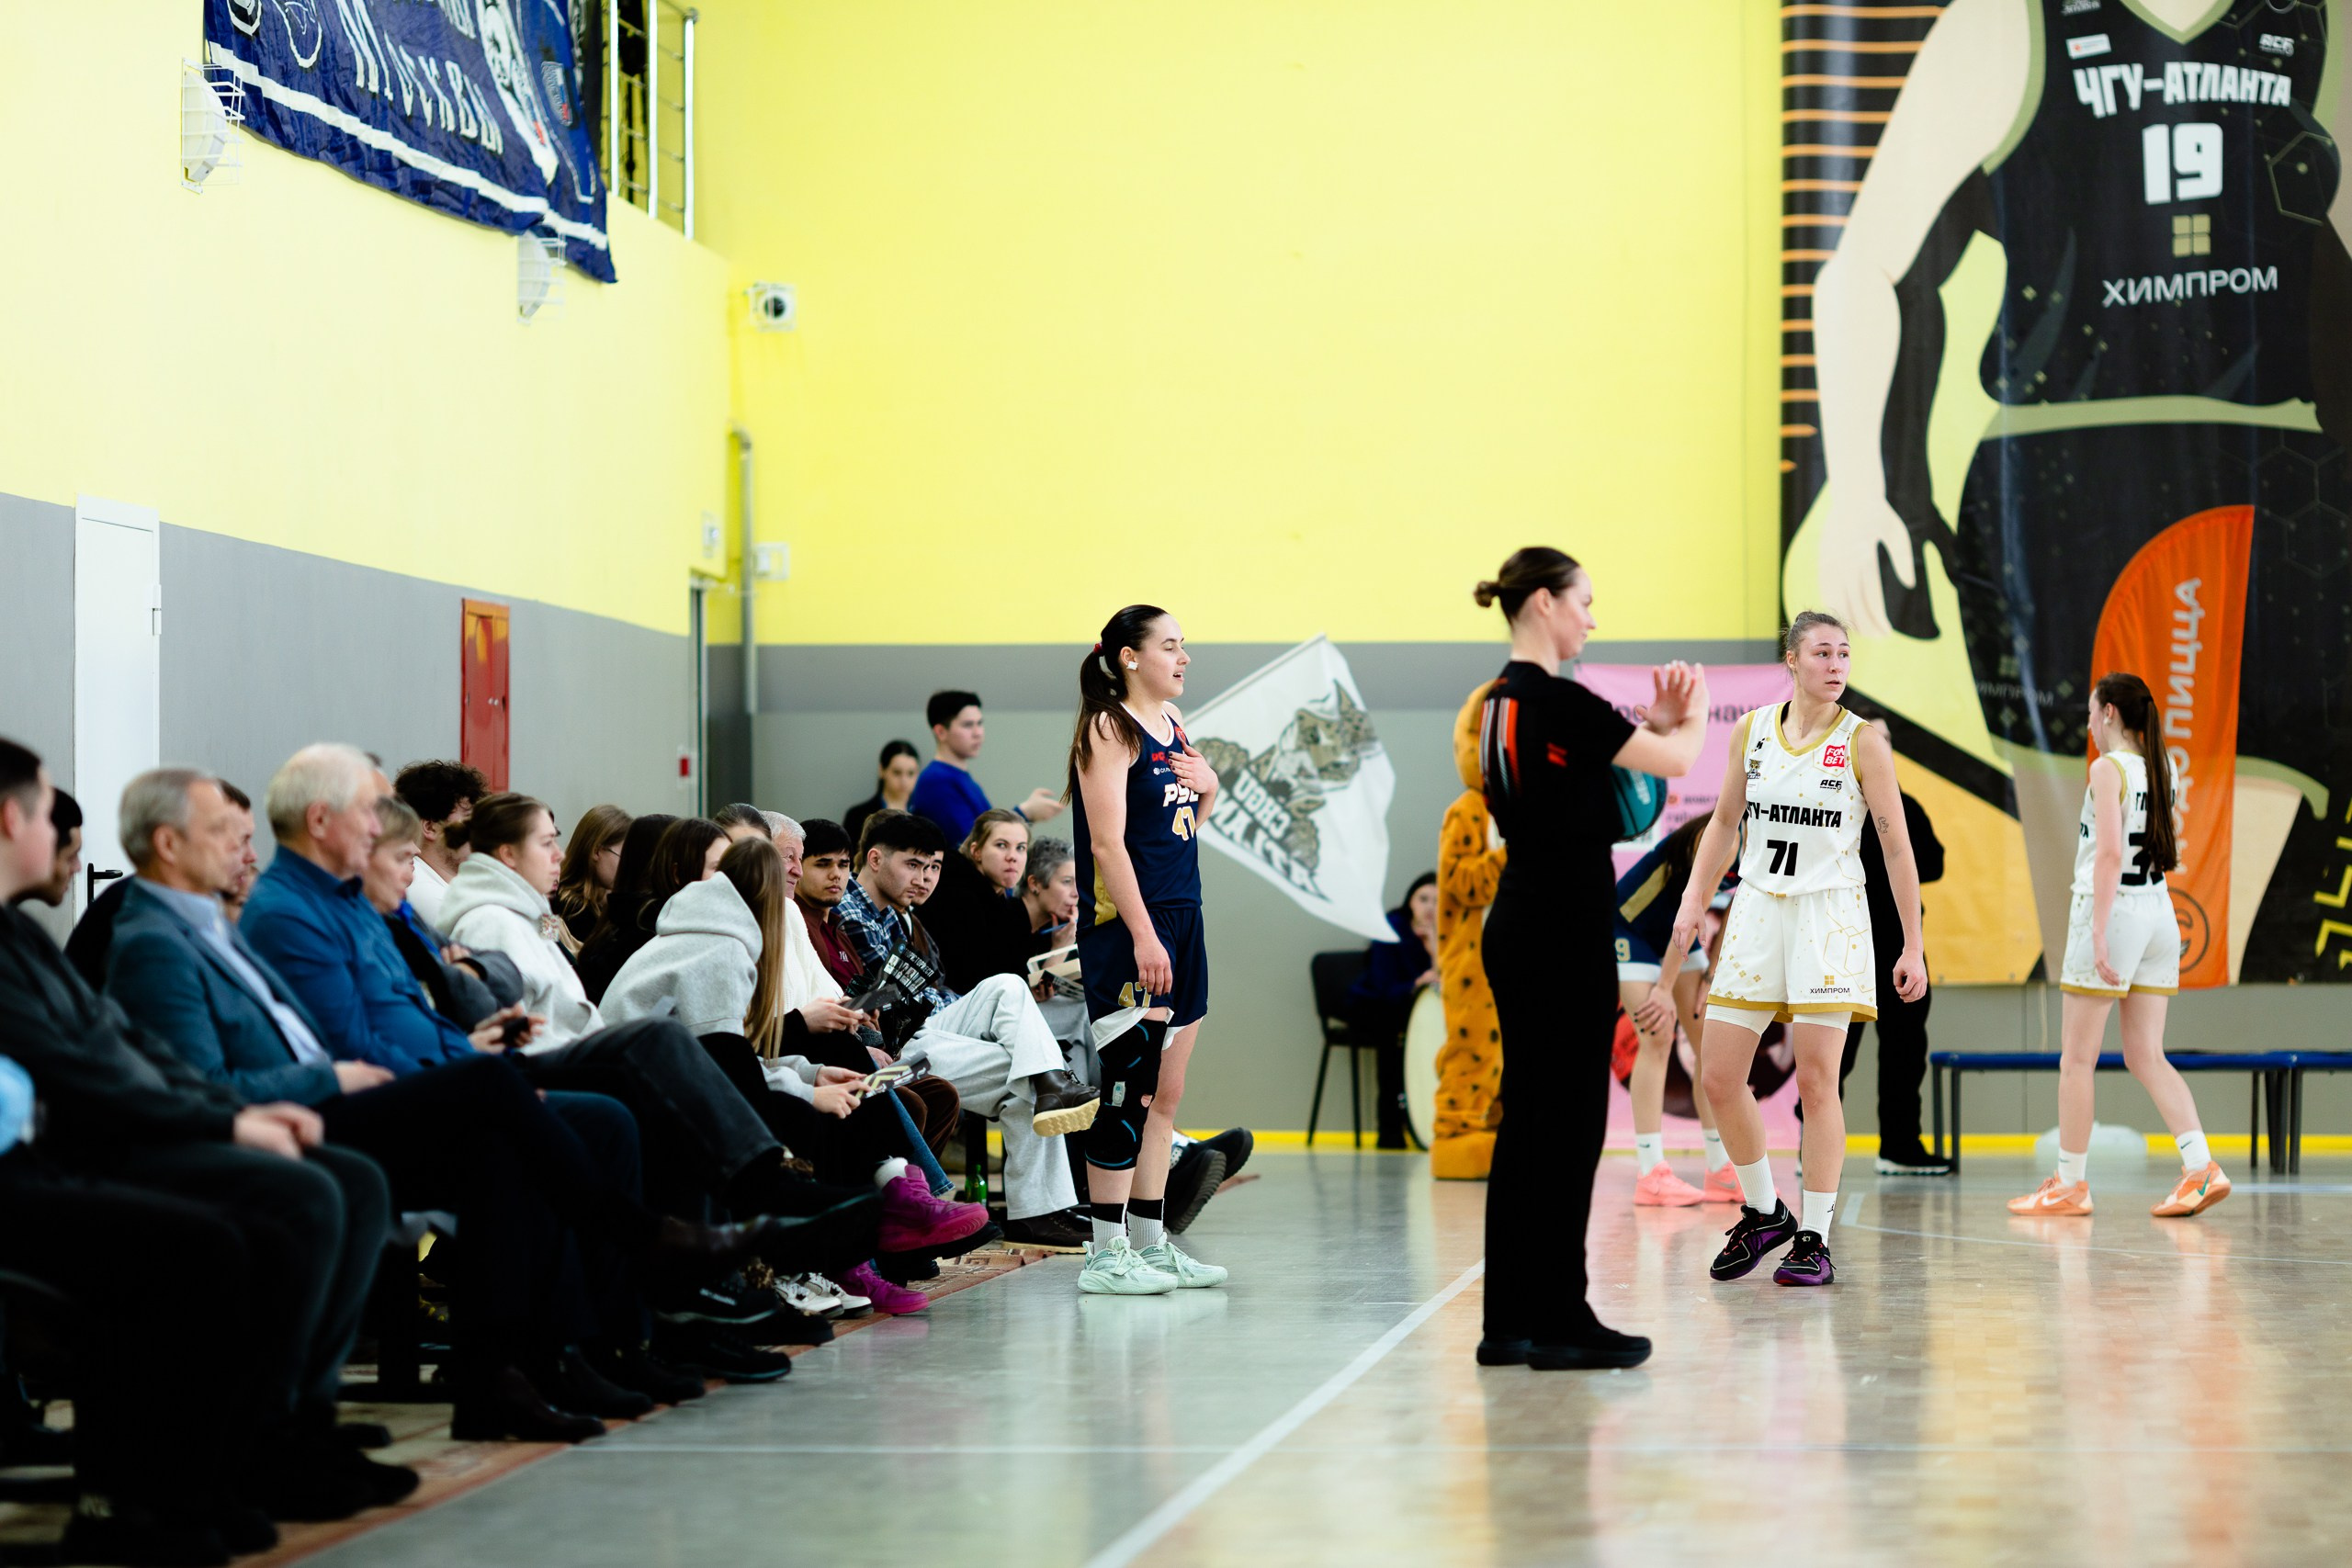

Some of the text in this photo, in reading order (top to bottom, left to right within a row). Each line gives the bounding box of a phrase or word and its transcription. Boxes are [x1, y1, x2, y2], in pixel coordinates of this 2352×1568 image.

[2073, 61, 2291, 118] ЧГУ-АТЛАНТА
[2143, 123, 2223, 205] 19
[2102, 265, 2278, 308] ХИМПРОМ
[2164, 577, 2205, 739] ПИЦЦА
[1825, 756, 1845, 765] BET
[1826, 747, 1845, 757] FON
[1172, 806, 1196, 840] 47
[1747, 801, 1842, 828] ГУ-АТЛАНТА
[1767, 840, 1798, 876] 71
